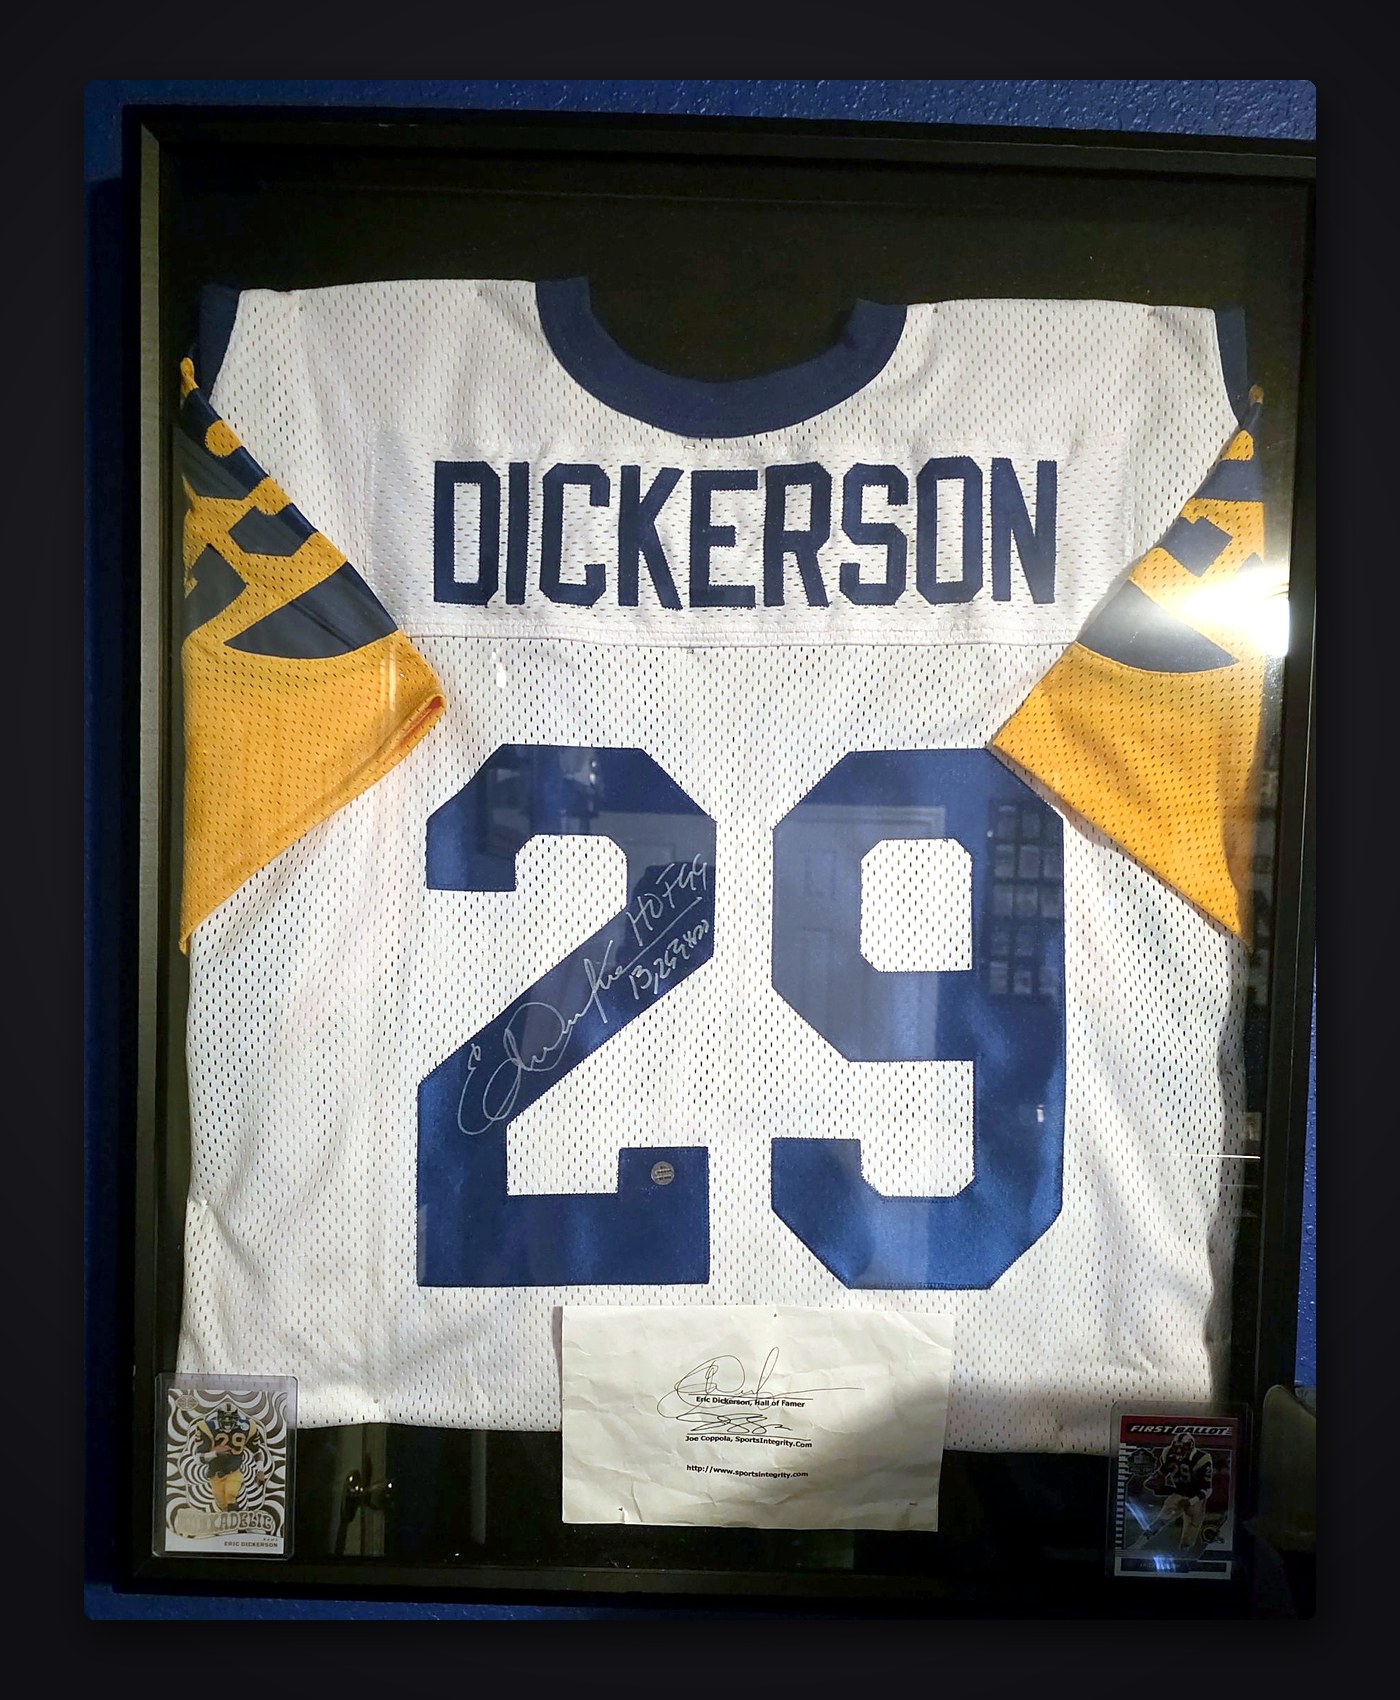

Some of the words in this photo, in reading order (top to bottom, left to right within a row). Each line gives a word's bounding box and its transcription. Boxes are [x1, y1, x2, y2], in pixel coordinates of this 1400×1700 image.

[432, 455, 1057, 609] DICKERSON
[416, 743, 1067, 1290] 29
[712, 1398, 752, 1407] Dickerson,
[781, 1400, 805, 1408] Famer
[1129, 1425, 1172, 1433] FIRST
[1174, 1426, 1228, 1434] BALLOT
[214, 1432, 247, 1455] 29
[735, 1436, 813, 1449] SportsIntegrity.Com
[686, 1464, 809, 1479] http://www.sportsintegrity.com
